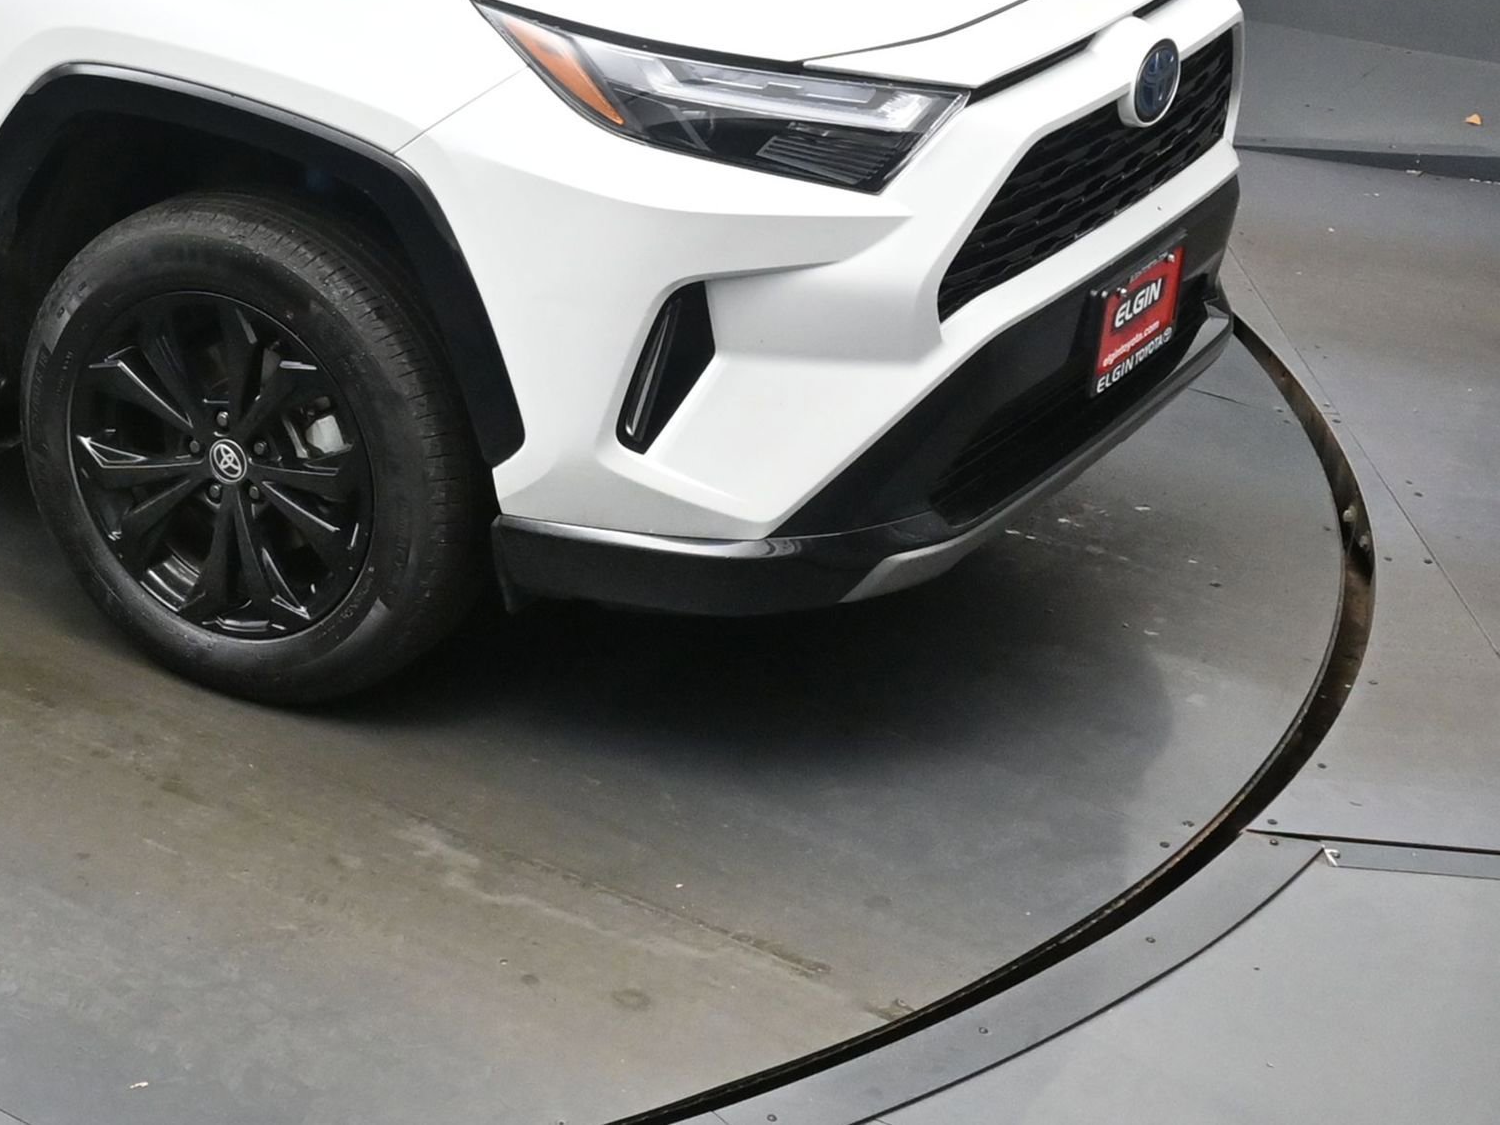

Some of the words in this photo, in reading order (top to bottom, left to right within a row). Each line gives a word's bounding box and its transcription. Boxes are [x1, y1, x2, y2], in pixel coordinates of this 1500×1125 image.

[1114, 277, 1162, 328] ELGIN
[1096, 354, 1134, 393] ELGIN
[1134, 334, 1164, 366] TOYOTA
